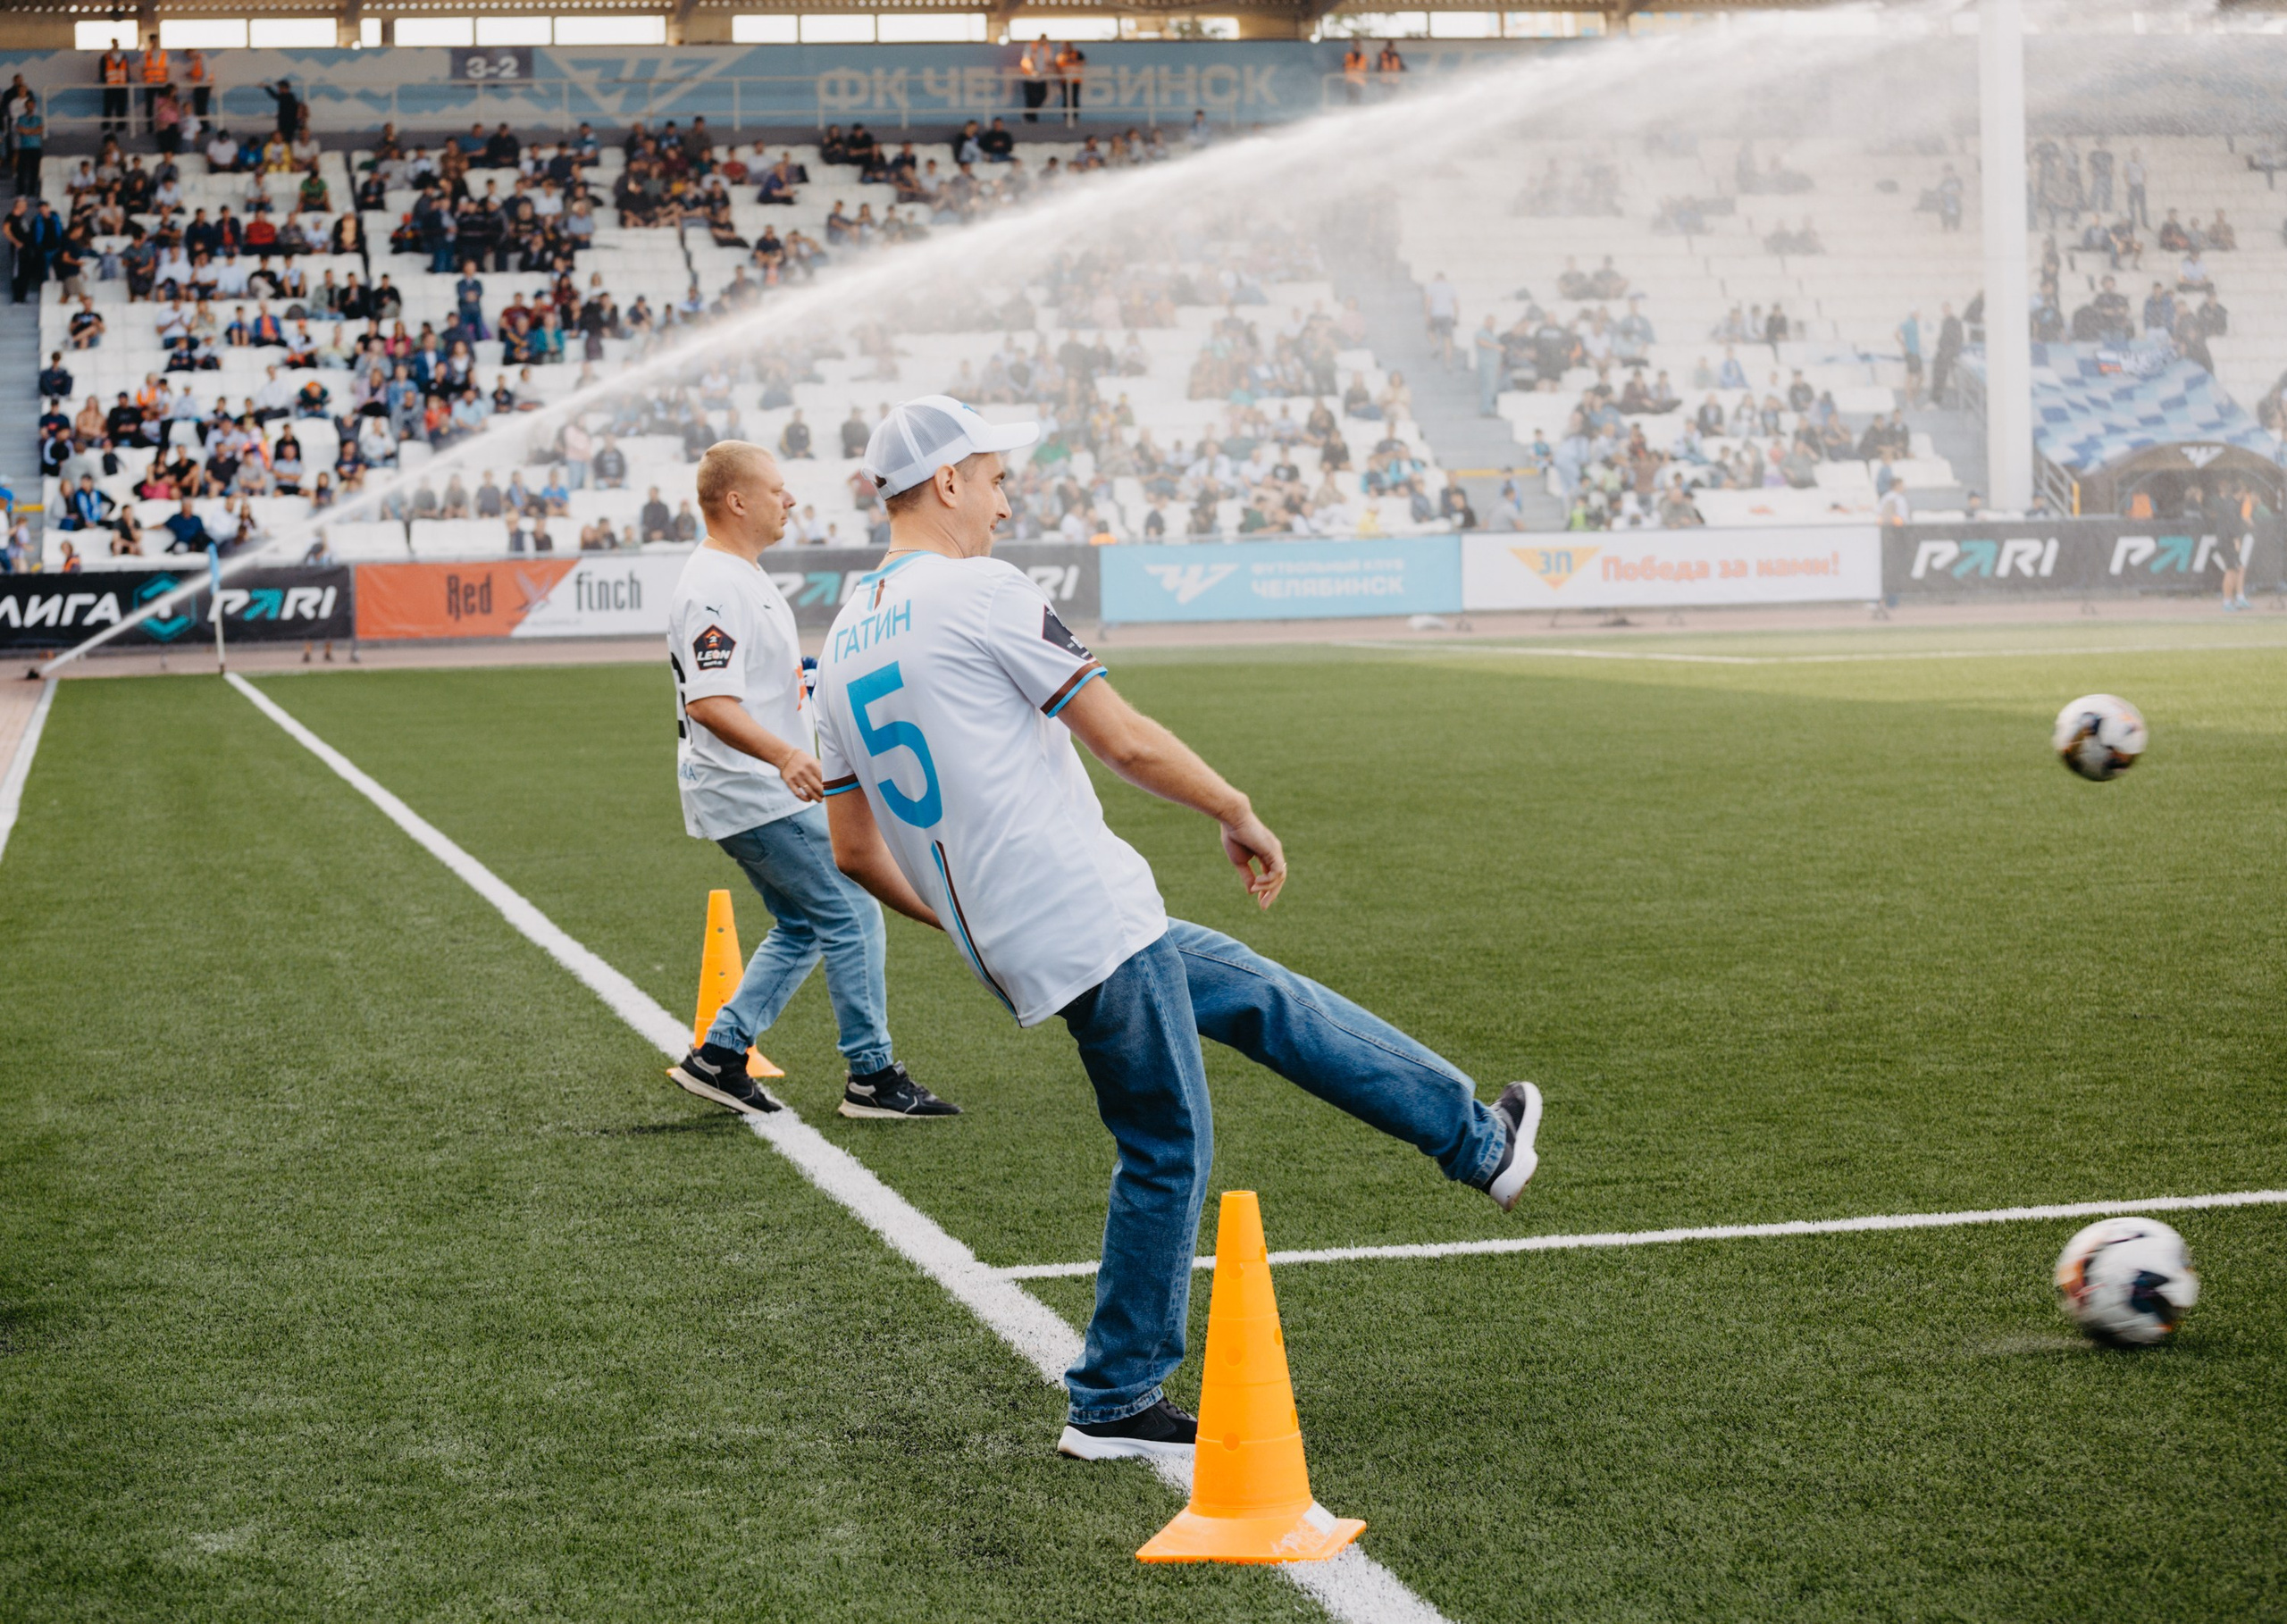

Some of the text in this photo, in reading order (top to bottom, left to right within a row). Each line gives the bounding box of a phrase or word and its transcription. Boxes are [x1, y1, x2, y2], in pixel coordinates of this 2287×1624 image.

[466, 55, 518, 79] 3-2
[816, 63, 1279, 112] ФК ЧЕЛБИНСК
[1602, 555, 1710, 582] Победа
[1718, 557, 1747, 578] за
[1910, 536, 2059, 580] PARI
[207, 585, 338, 623] PARI
[447, 570, 642, 621] Red finch
[1251, 575, 1404, 599] ЧЕЛЯБИНСК
[0, 590, 123, 628] ЛИГА
[834, 599, 911, 664] ГАТИН
[697, 649, 732, 661] LEON
[846, 660, 942, 829] 5
